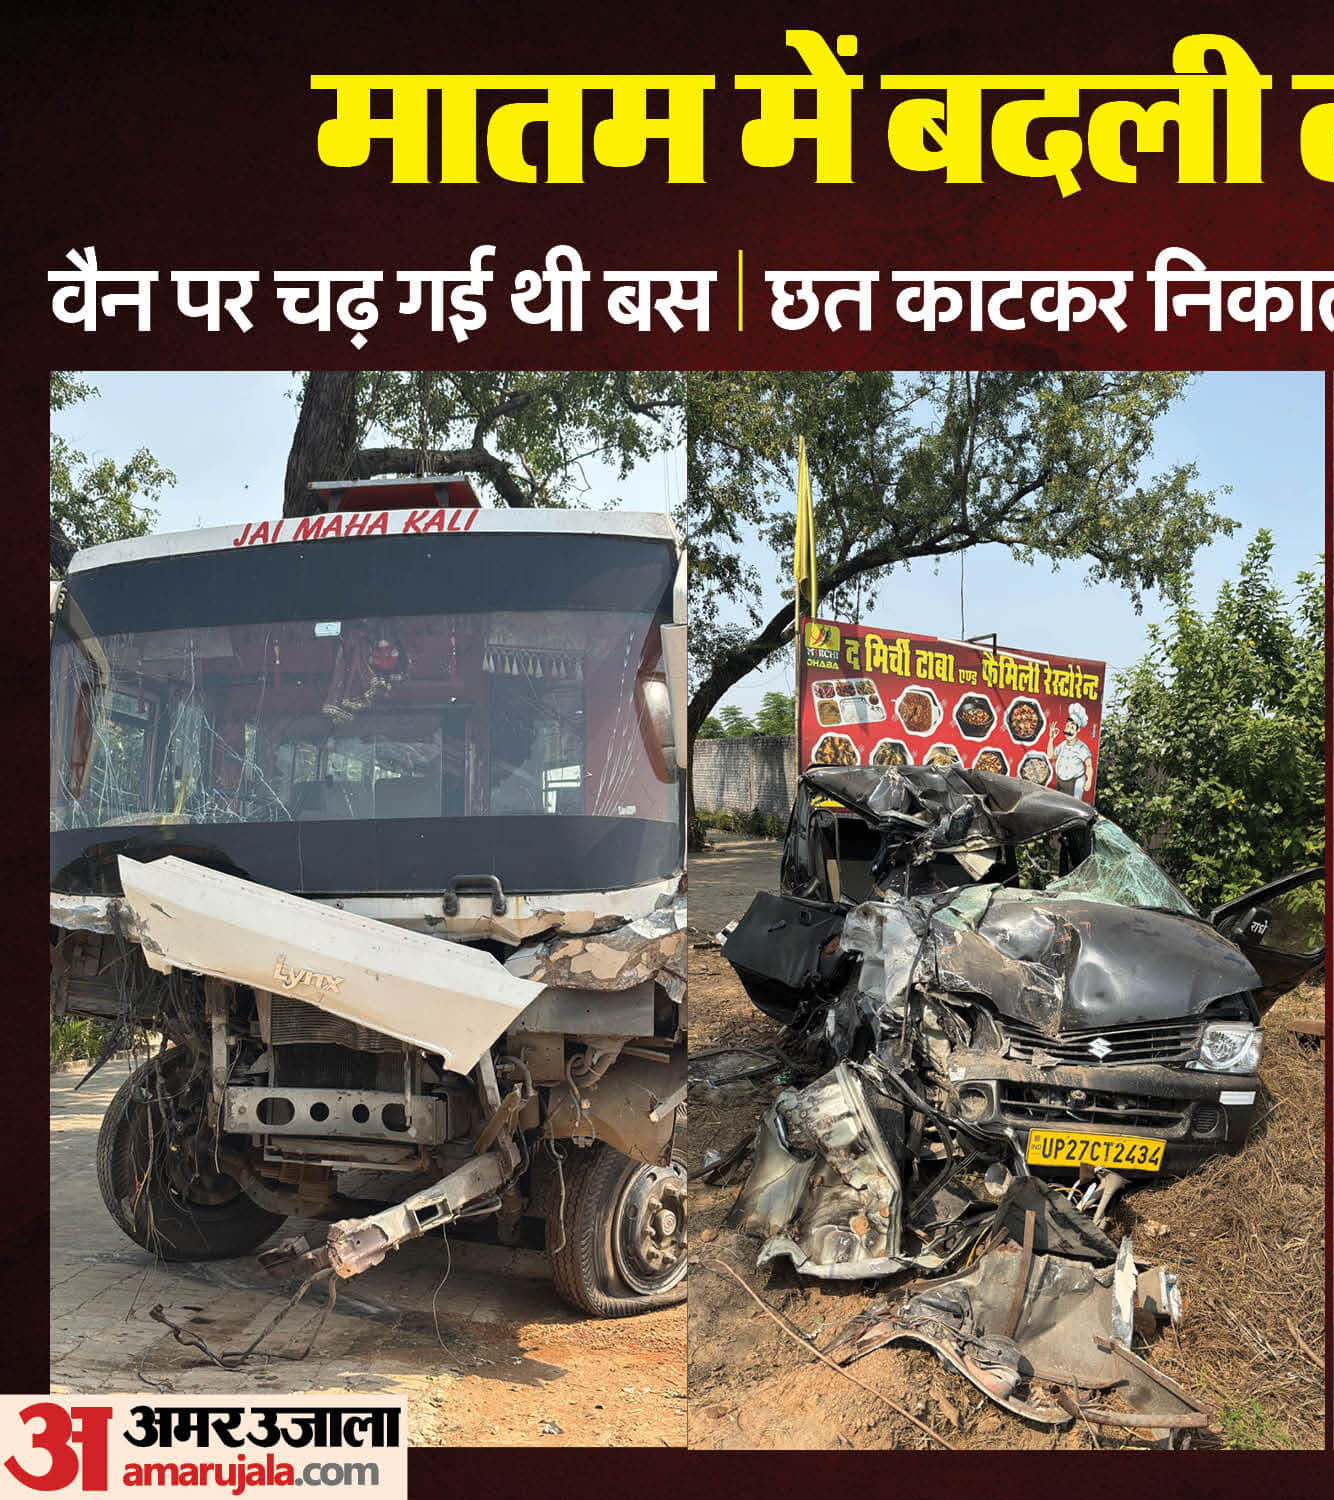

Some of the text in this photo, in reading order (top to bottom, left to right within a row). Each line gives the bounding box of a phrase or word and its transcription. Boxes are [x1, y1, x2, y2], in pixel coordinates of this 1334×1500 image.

[233, 508, 479, 547] JAI MAHA KALI
[806, 647, 839, 660] MIRCHI
[845, 639, 860, 671] द
[273, 954, 345, 993] Lynx
[1042, 1136, 1161, 1166] UP27CT2434
